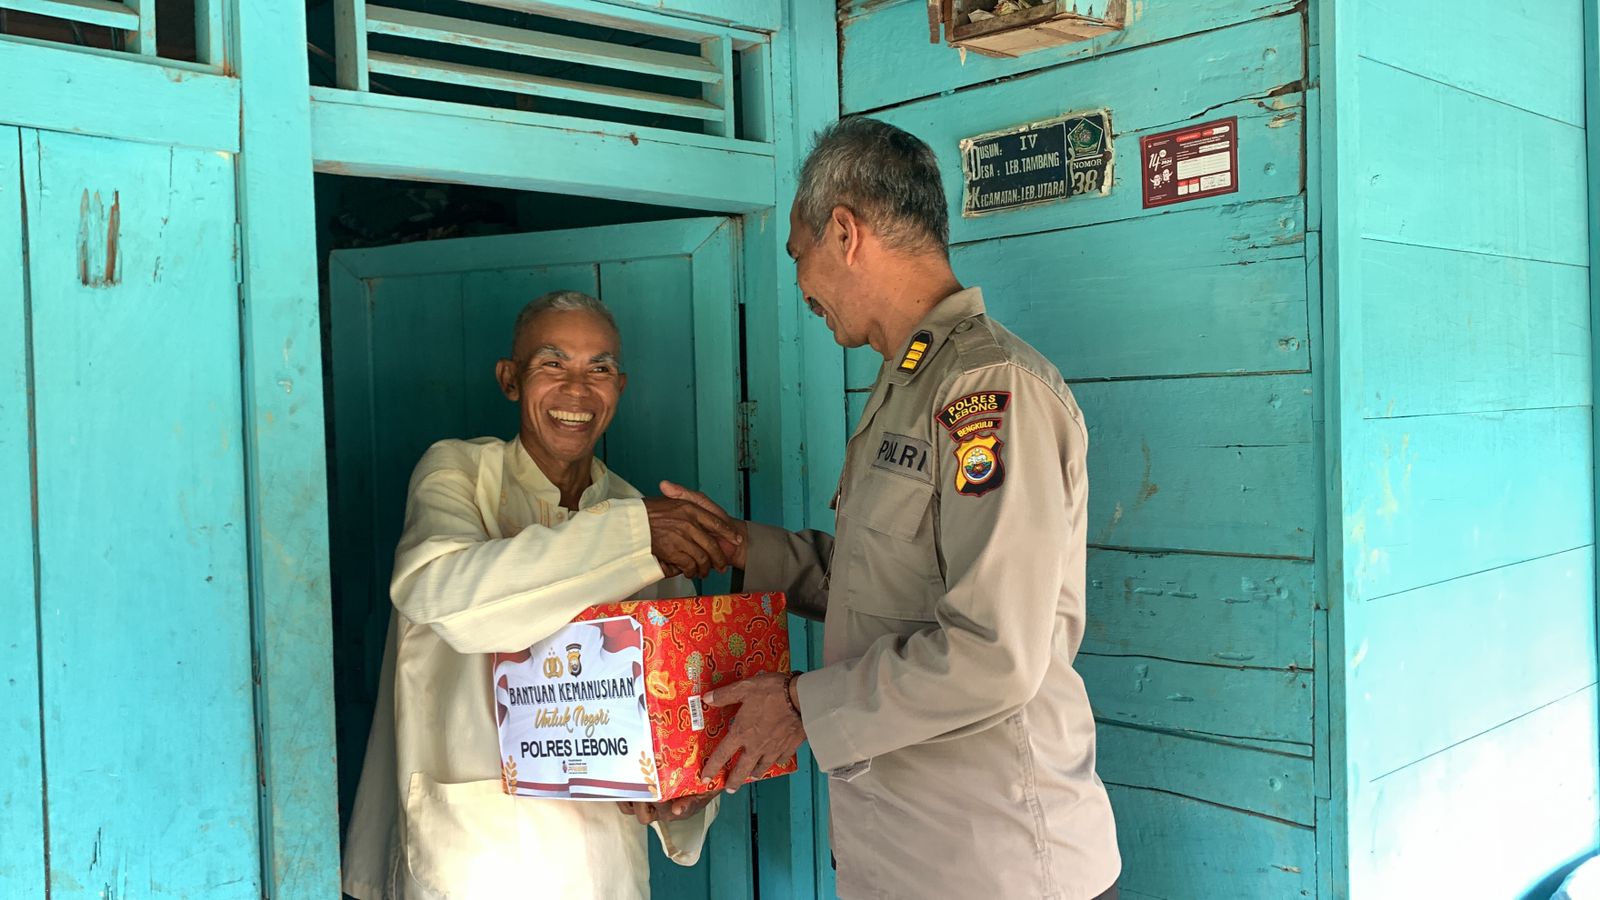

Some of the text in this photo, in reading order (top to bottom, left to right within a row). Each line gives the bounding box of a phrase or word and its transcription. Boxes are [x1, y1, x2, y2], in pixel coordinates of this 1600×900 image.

[1019, 133, 1038, 151] IV
[1073, 158, 1103, 170] NOMOR
[1148, 153, 1161, 172] 14
[1072, 169, 1098, 195] 38
[948, 394, 996, 416] POLRES
[949, 402, 998, 425] LEBONG
[957, 420, 993, 437] BENGKULU
[877, 440, 927, 472] POLRI
[508, 677, 636, 706] BANTUAN KEMANUSIAAN
[534, 705, 574, 733] Untuk
[521, 737, 629, 758] POLRES LEBONG
